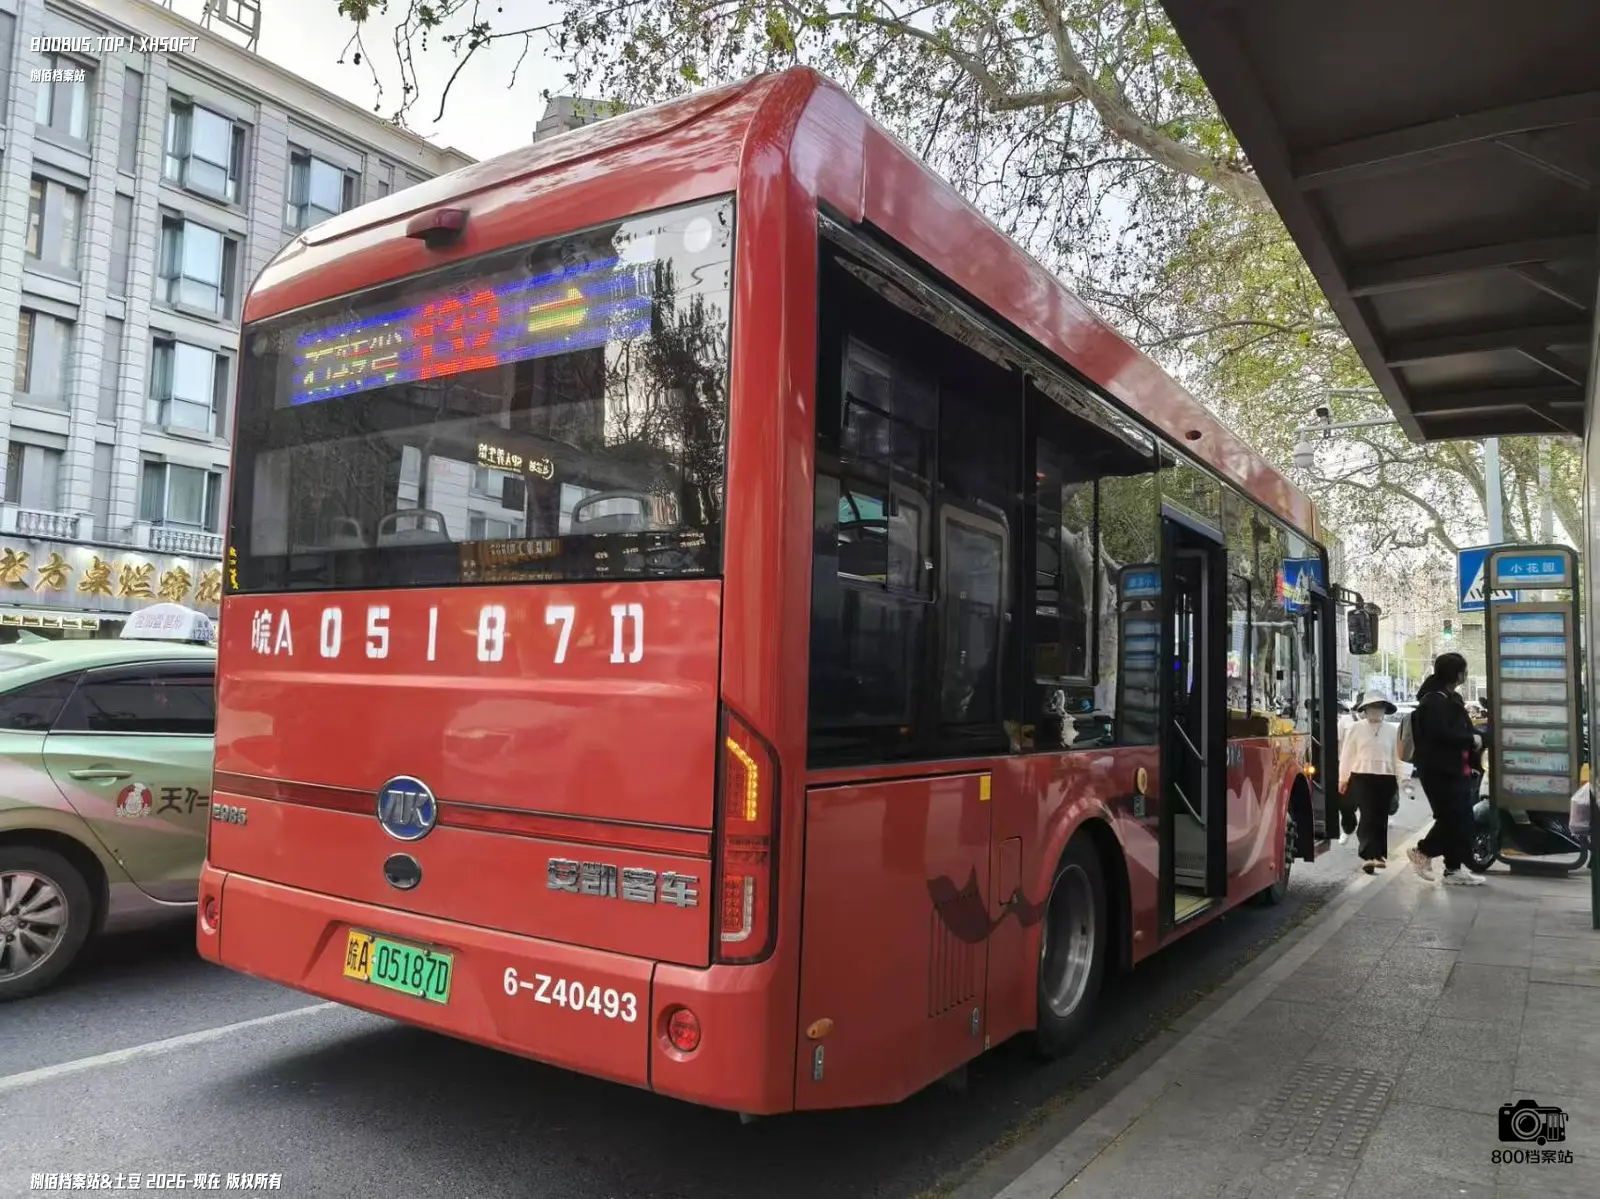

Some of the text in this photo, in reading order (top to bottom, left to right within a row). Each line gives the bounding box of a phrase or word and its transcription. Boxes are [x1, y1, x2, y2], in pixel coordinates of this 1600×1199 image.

[1510, 562, 1556, 574] 小花园
[547, 858, 699, 908] 安凯客车
[503, 966, 638, 1023] 6-Z40493
